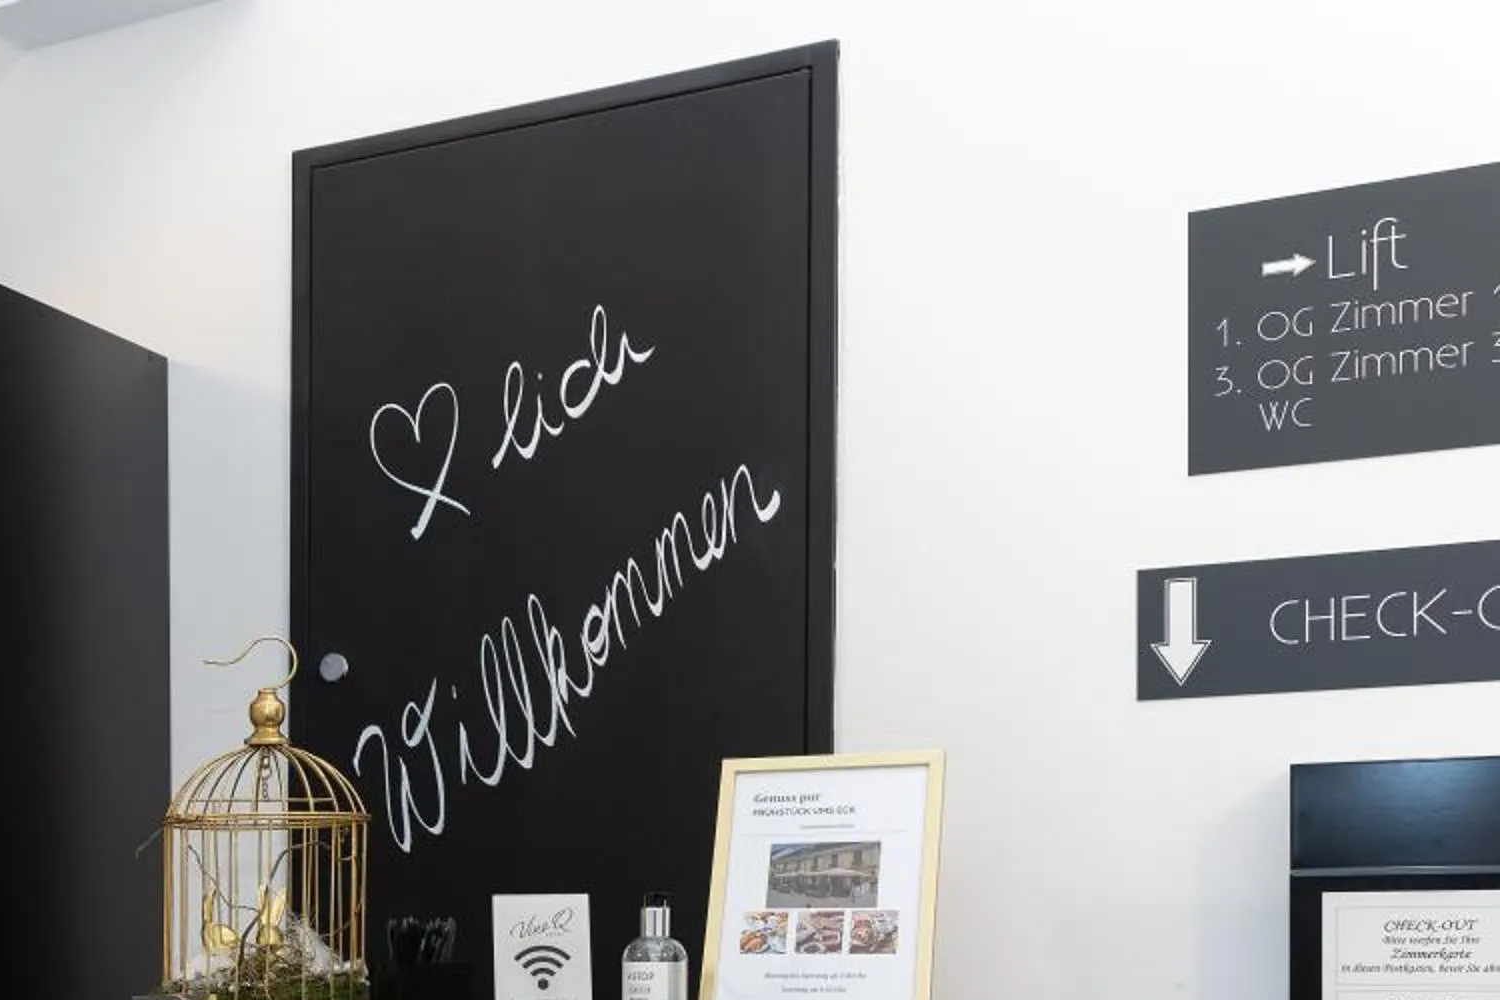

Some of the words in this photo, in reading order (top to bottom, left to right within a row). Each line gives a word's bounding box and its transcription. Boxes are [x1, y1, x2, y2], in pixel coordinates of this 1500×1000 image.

[1327, 216, 1409, 291] Lift
[1216, 317, 1243, 348] 1.
[1257, 305, 1314, 341] OG
[1330, 291, 1475, 334] Zimmer
[1213, 365, 1243, 397] 3.
[1257, 354, 1314, 389] OG
[1330, 341, 1475, 383] Zimmer
[1258, 397, 1313, 432] WC
[353, 463, 781, 854] Willkommen
[1383, 919, 1479, 933] CHECK-OUT
